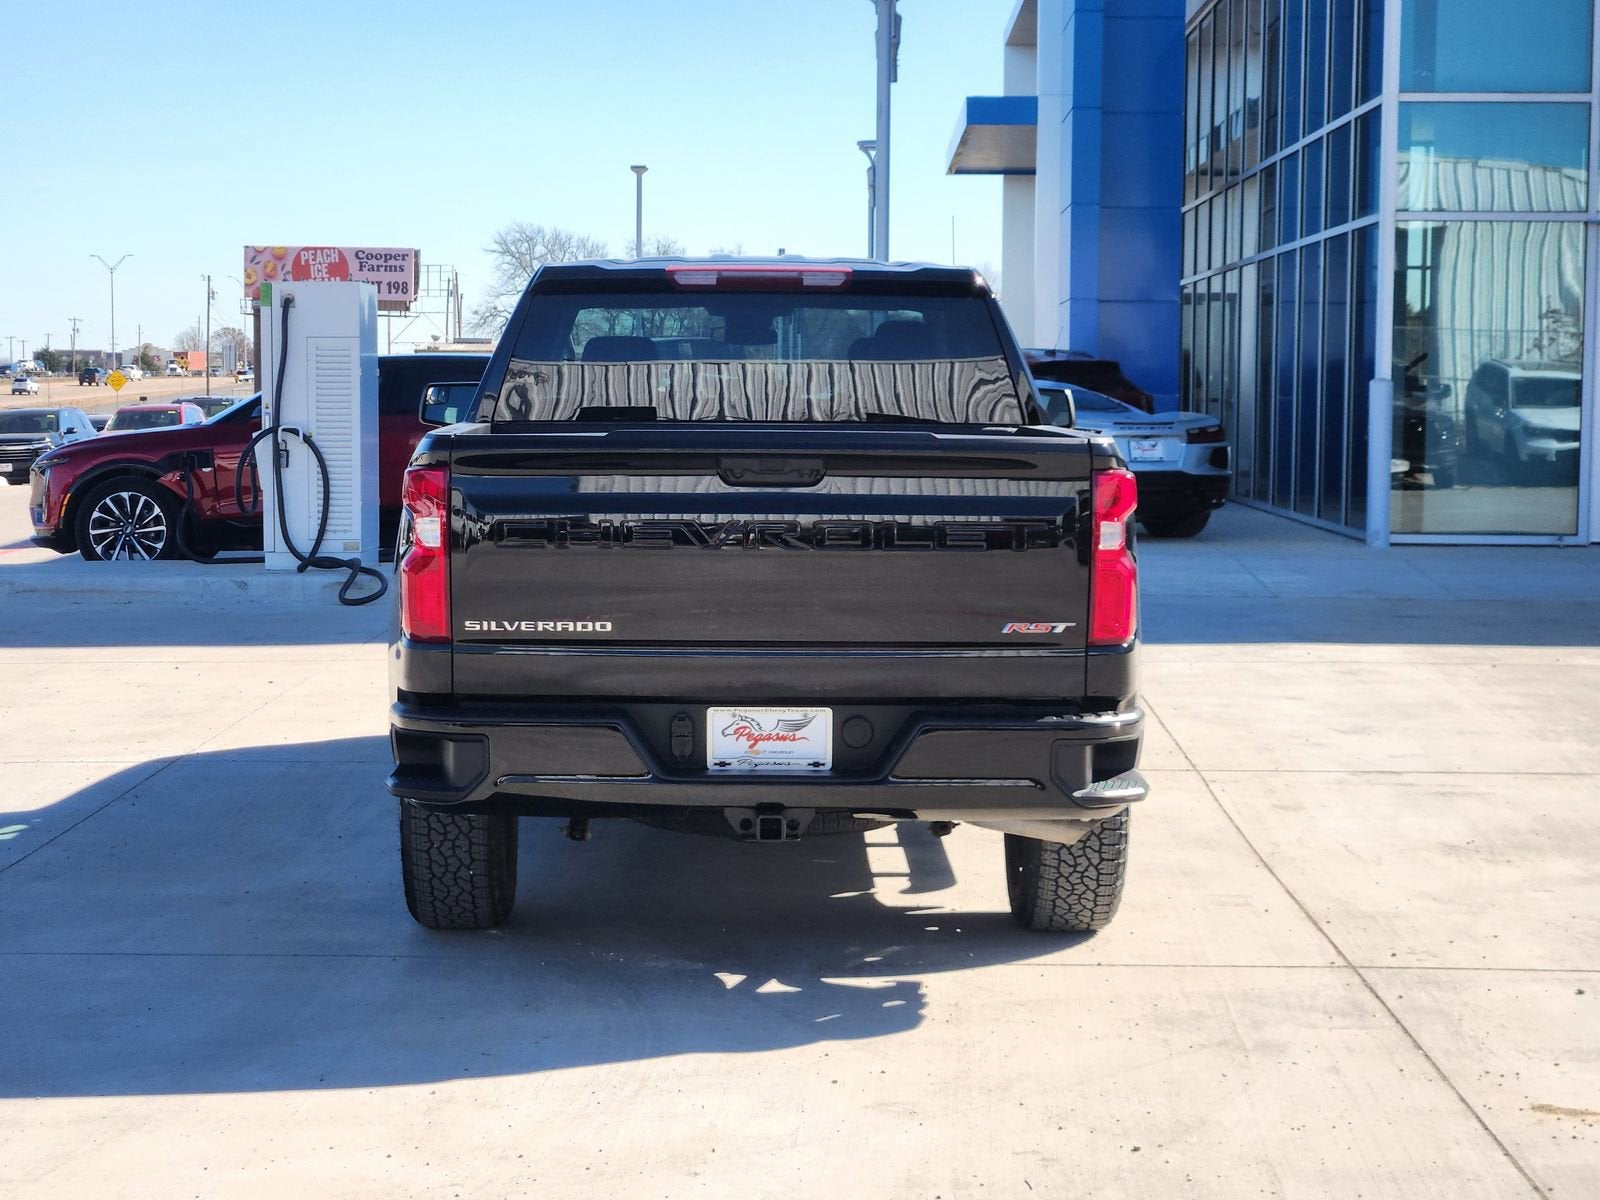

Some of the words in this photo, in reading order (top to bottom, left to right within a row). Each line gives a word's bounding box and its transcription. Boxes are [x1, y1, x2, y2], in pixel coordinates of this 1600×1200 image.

[300, 248, 339, 265] PEACH
[354, 250, 409, 263] Cooper
[310, 263, 328, 279] ICE
[358, 261, 405, 273] Farms
[386, 281, 409, 294] 198
[494, 519, 1048, 550] CHEVROLET
[464, 620, 612, 632] SILVERADO
[1001, 622, 1077, 634] RST
[733, 725, 810, 750] Pegasus
